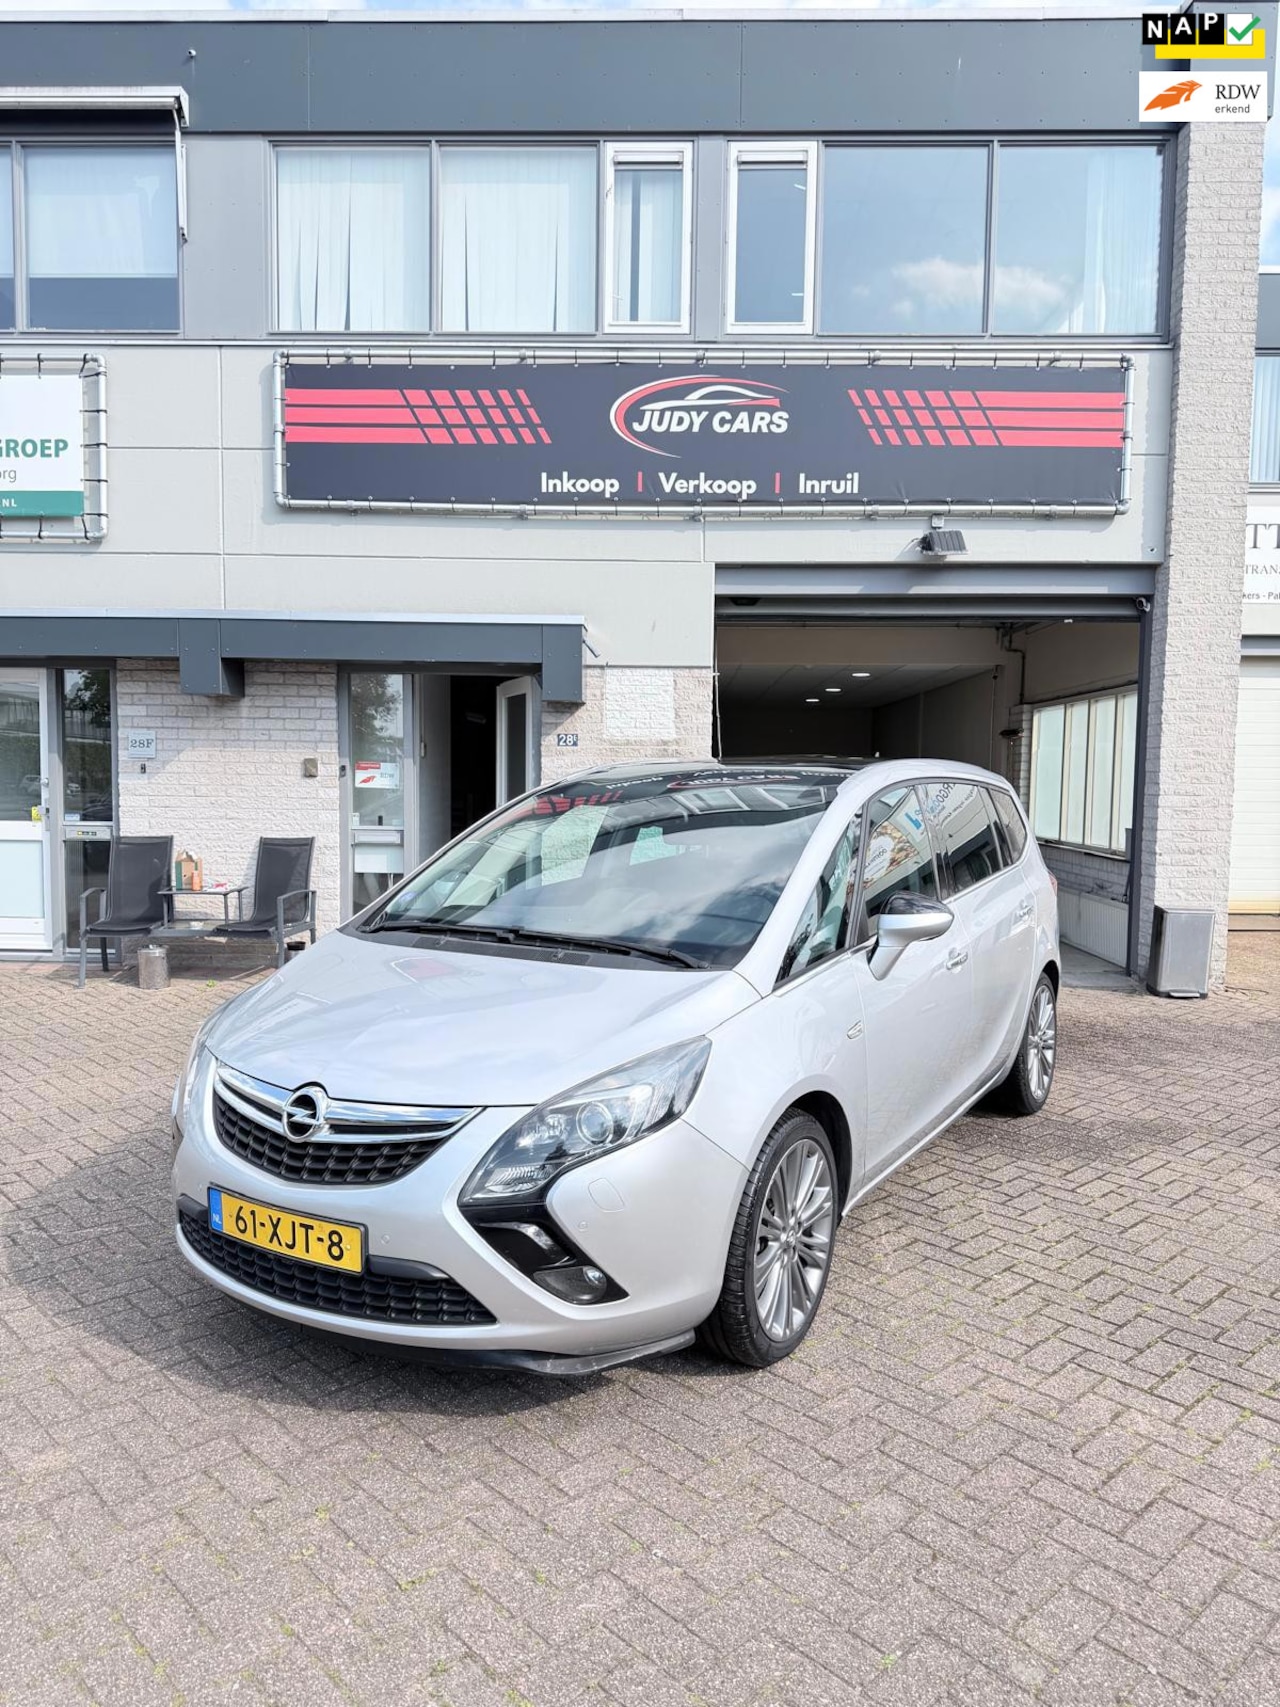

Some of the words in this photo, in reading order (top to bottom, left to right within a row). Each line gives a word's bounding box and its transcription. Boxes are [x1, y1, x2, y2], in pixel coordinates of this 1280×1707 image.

[632, 410, 708, 433] JUDY
[712, 410, 790, 434] CARS
[541, 471, 620, 498] Inkoop
[658, 471, 757, 500] Verkoop
[799, 472, 860, 495] Inruil
[130, 738, 154, 749] 28F
[235, 1205, 344, 1262] 61-XJT-8
